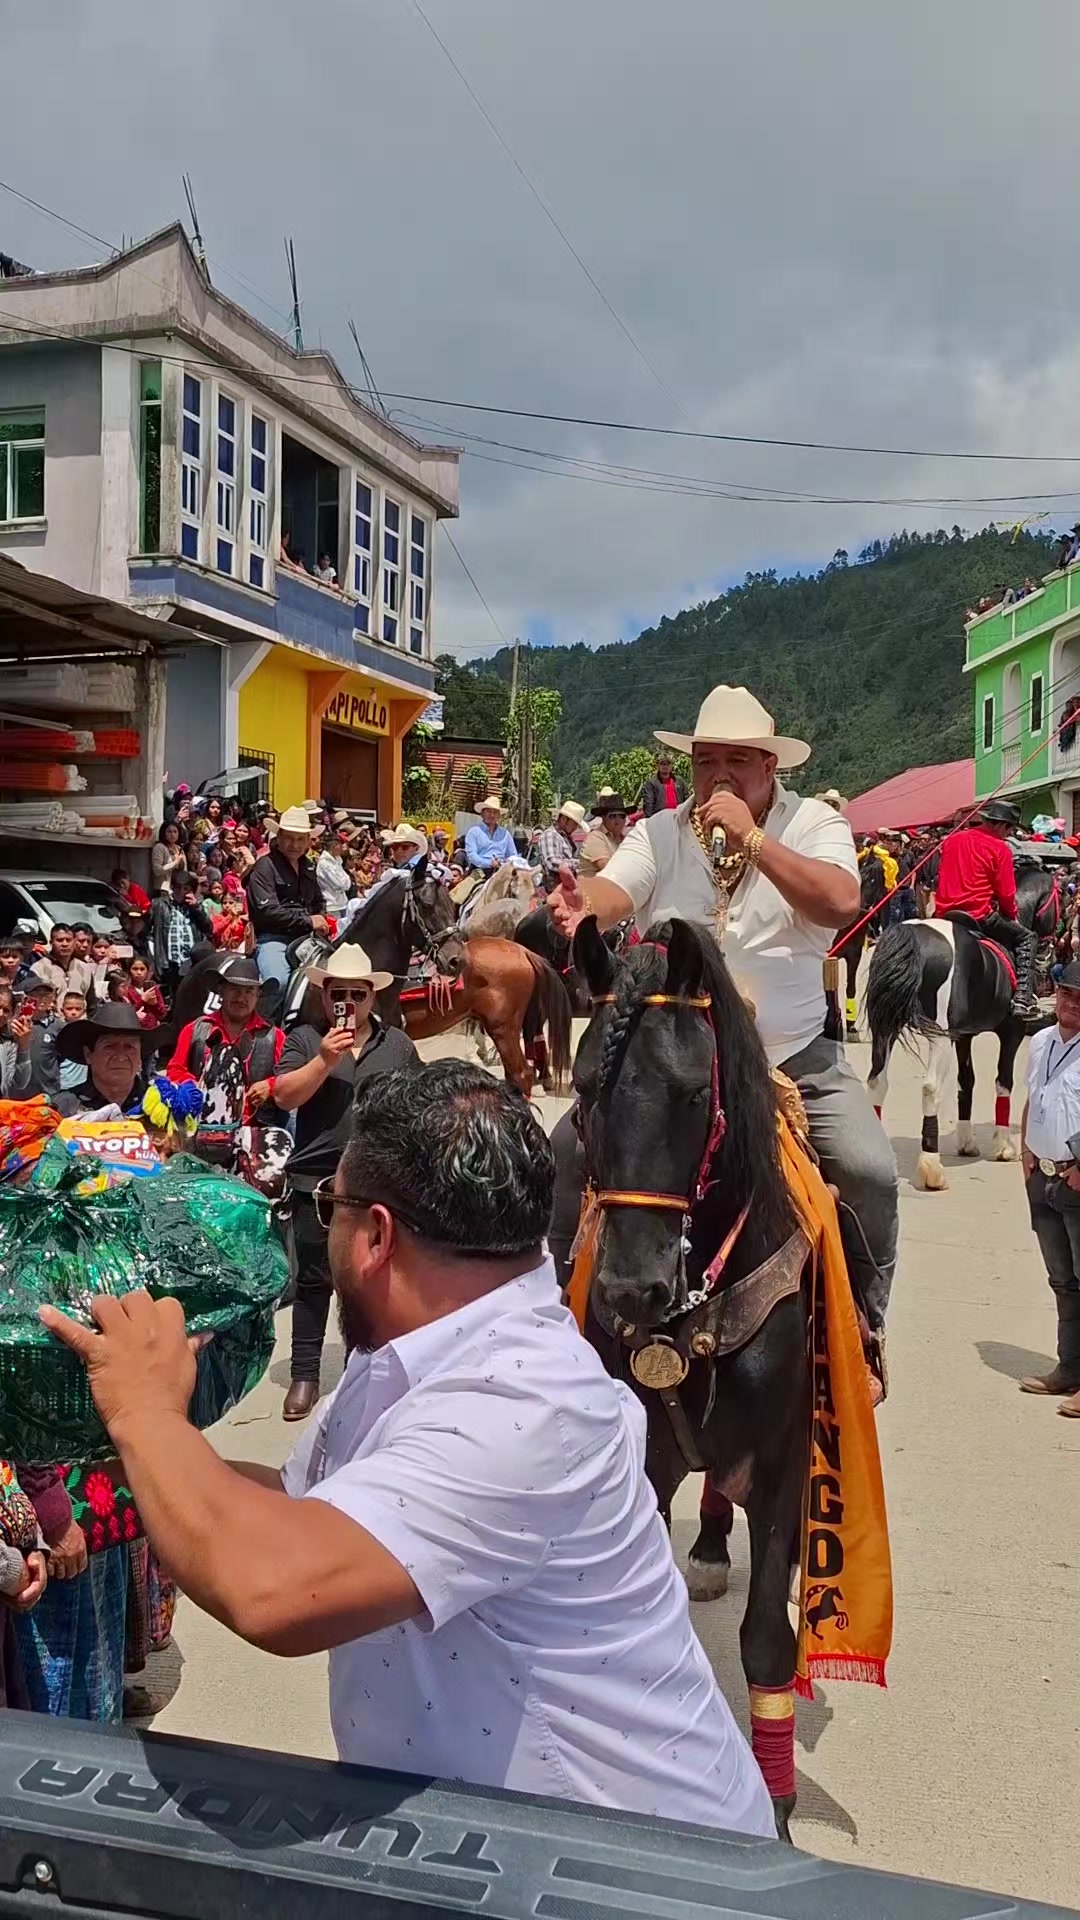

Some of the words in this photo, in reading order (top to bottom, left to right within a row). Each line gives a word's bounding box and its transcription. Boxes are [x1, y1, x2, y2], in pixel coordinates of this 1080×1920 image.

[350, 695, 387, 729] POLLO
[73, 1134, 150, 1154] Tropi
[16, 1758, 503, 1875] TUNDRA
